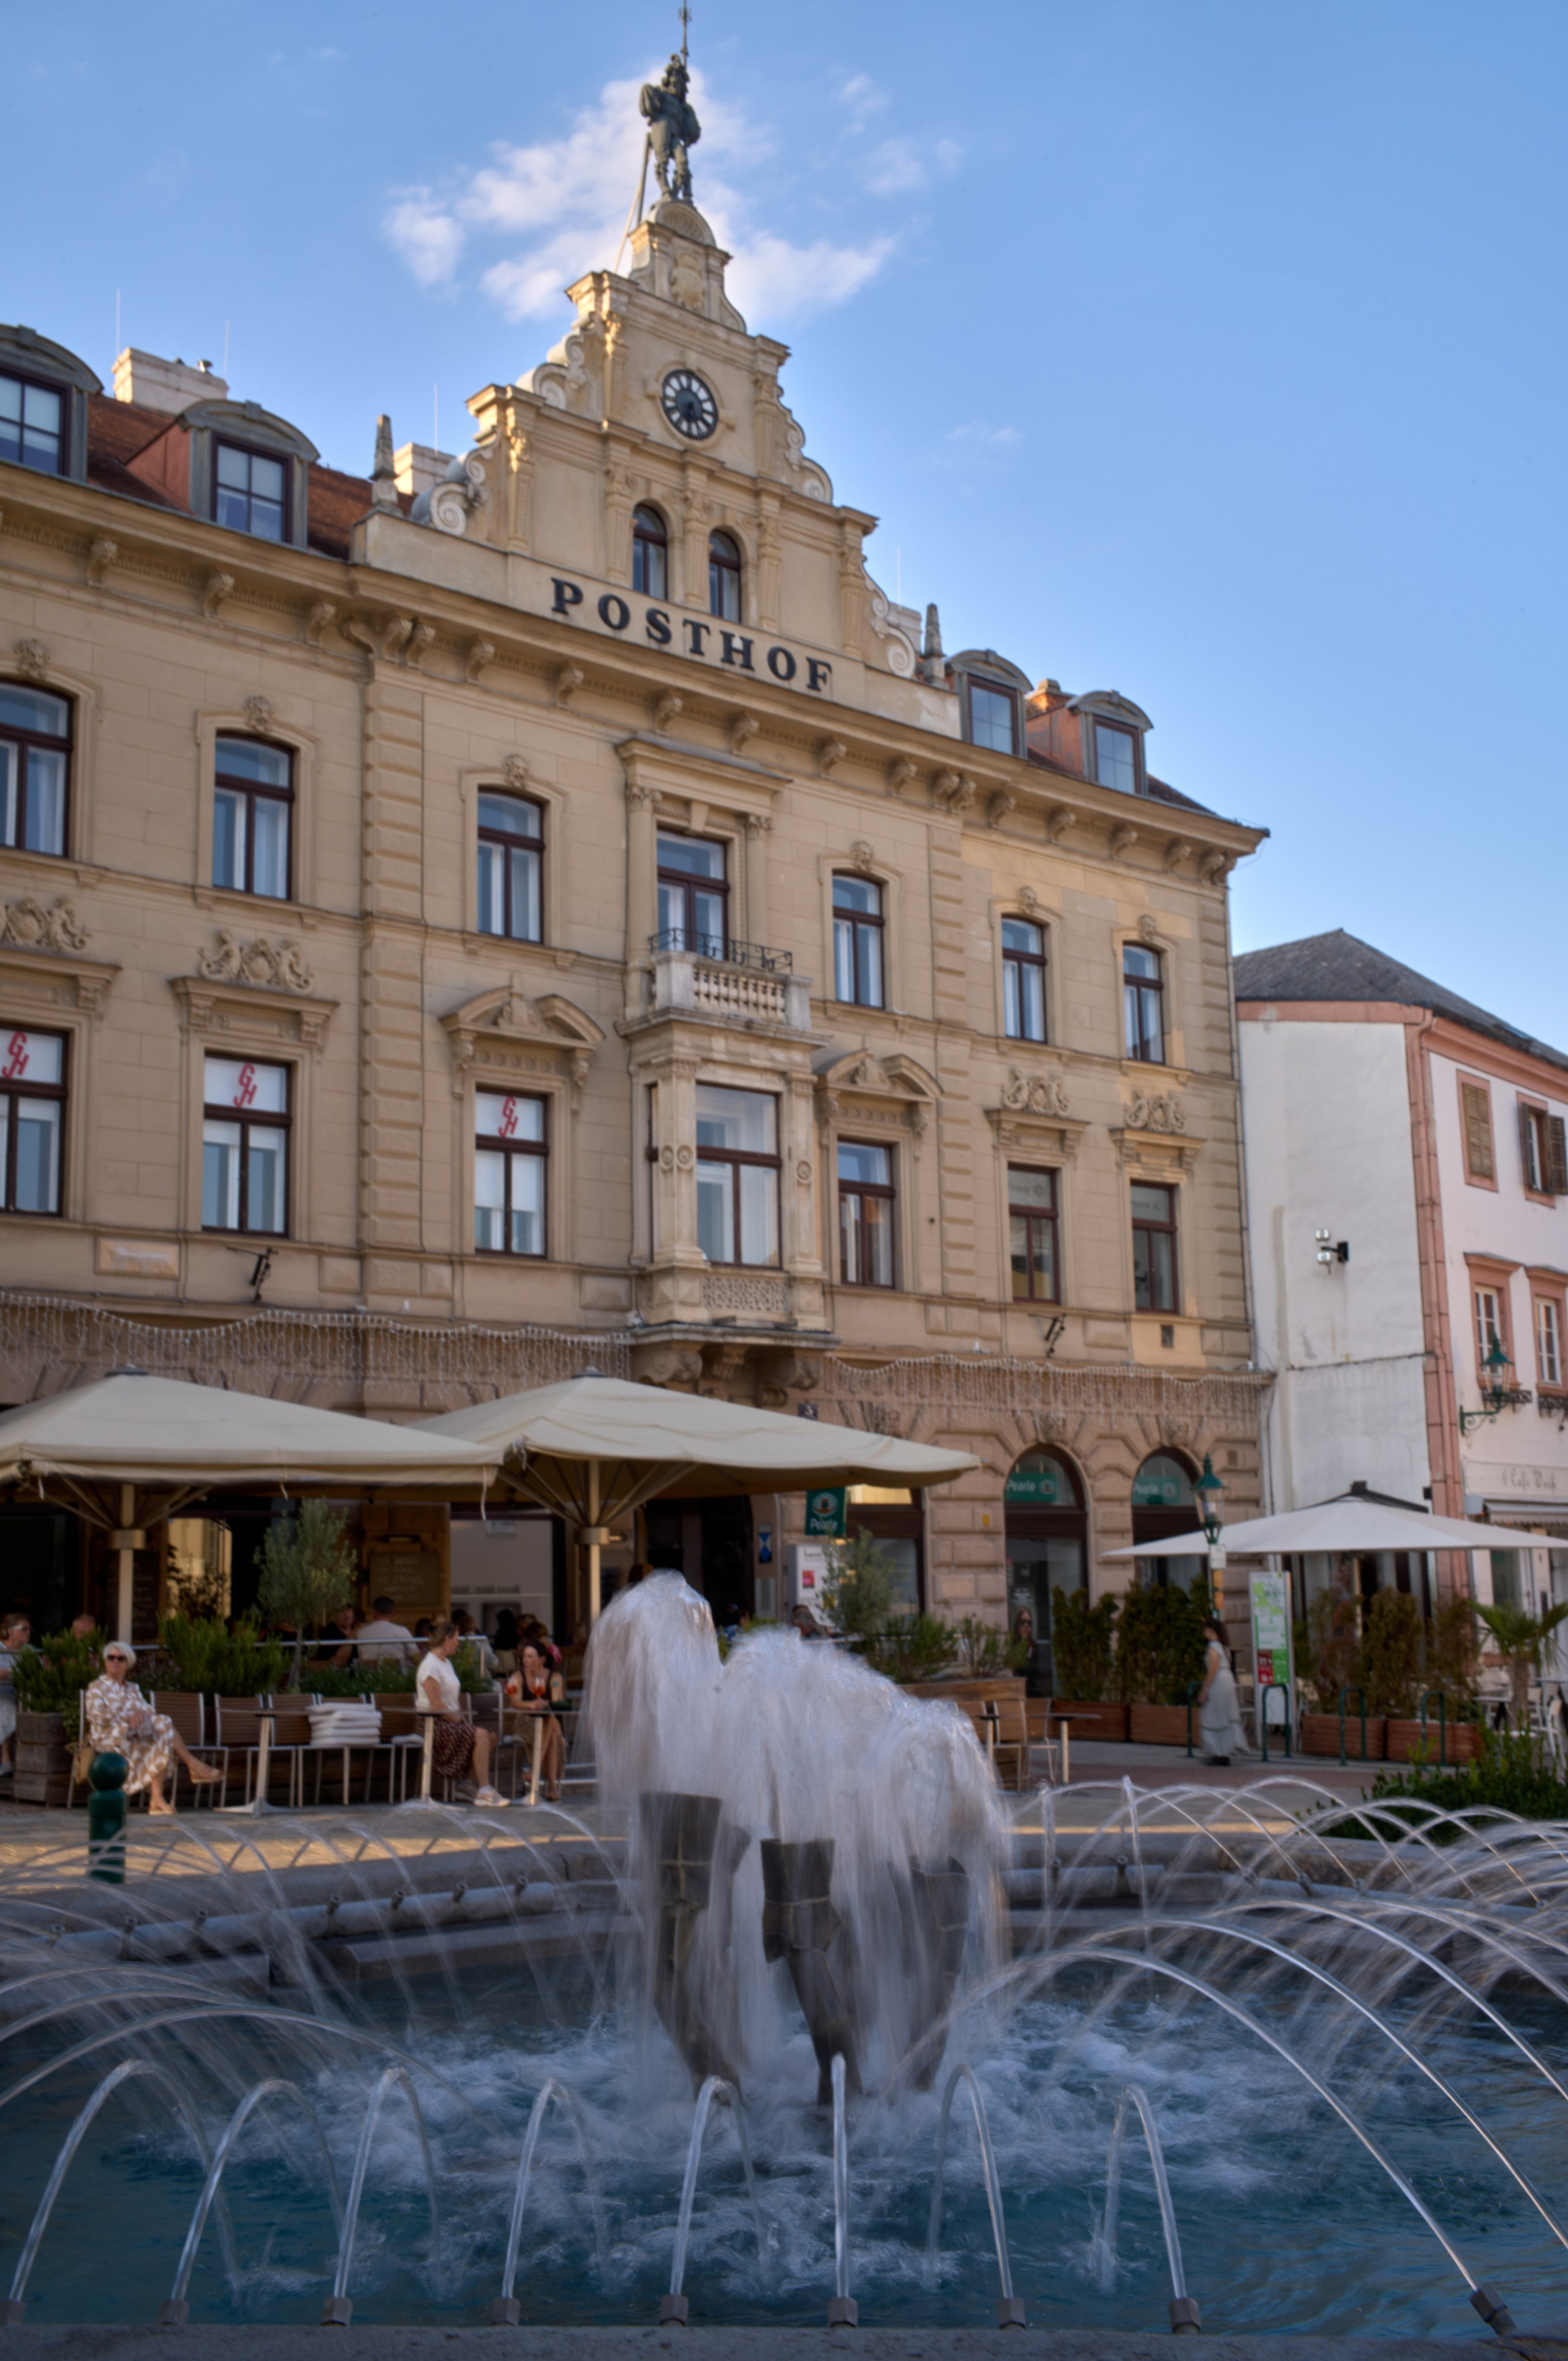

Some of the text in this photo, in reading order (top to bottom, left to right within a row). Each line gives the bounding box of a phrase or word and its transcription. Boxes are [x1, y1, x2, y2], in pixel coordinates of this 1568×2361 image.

[551, 577, 832, 691] POSTHOF
[1006, 1478, 1036, 1492] Pearle
[1133, 1482, 1159, 1495] Pearle
[810, 1518, 838, 1531] Pearle
